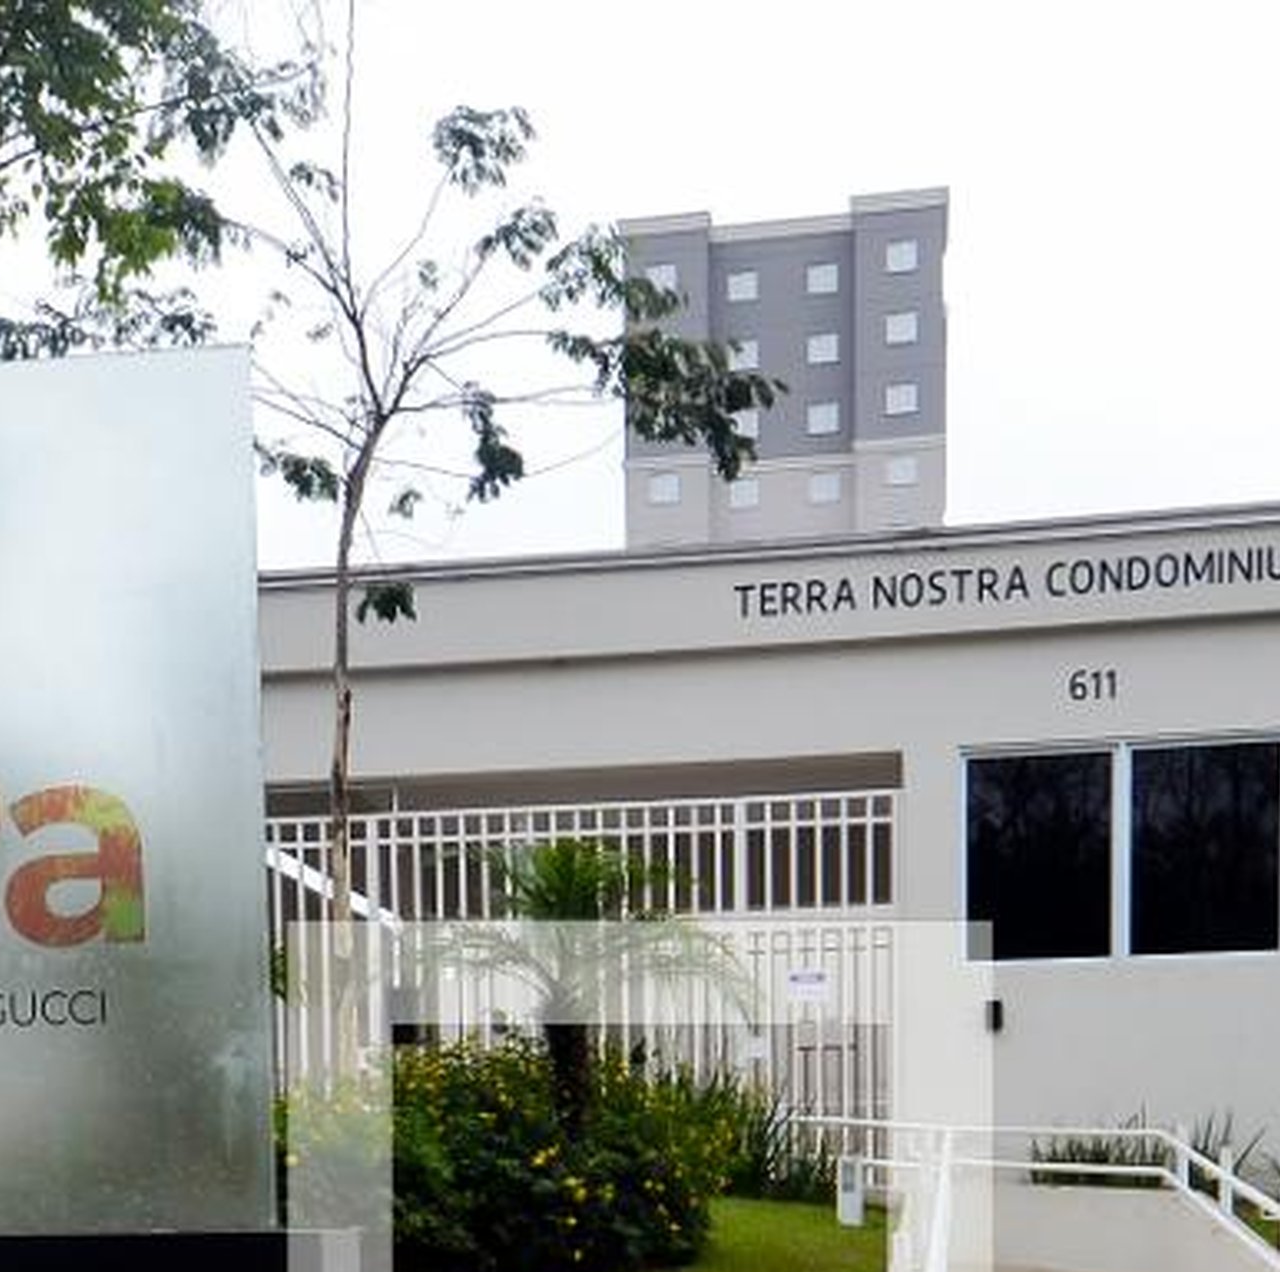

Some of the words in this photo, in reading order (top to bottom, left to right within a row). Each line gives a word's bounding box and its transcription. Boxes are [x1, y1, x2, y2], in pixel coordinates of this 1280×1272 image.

[734, 578, 857, 618] TERRA
[871, 564, 1031, 608] NOSTRA
[1068, 669, 1119, 702] 611
